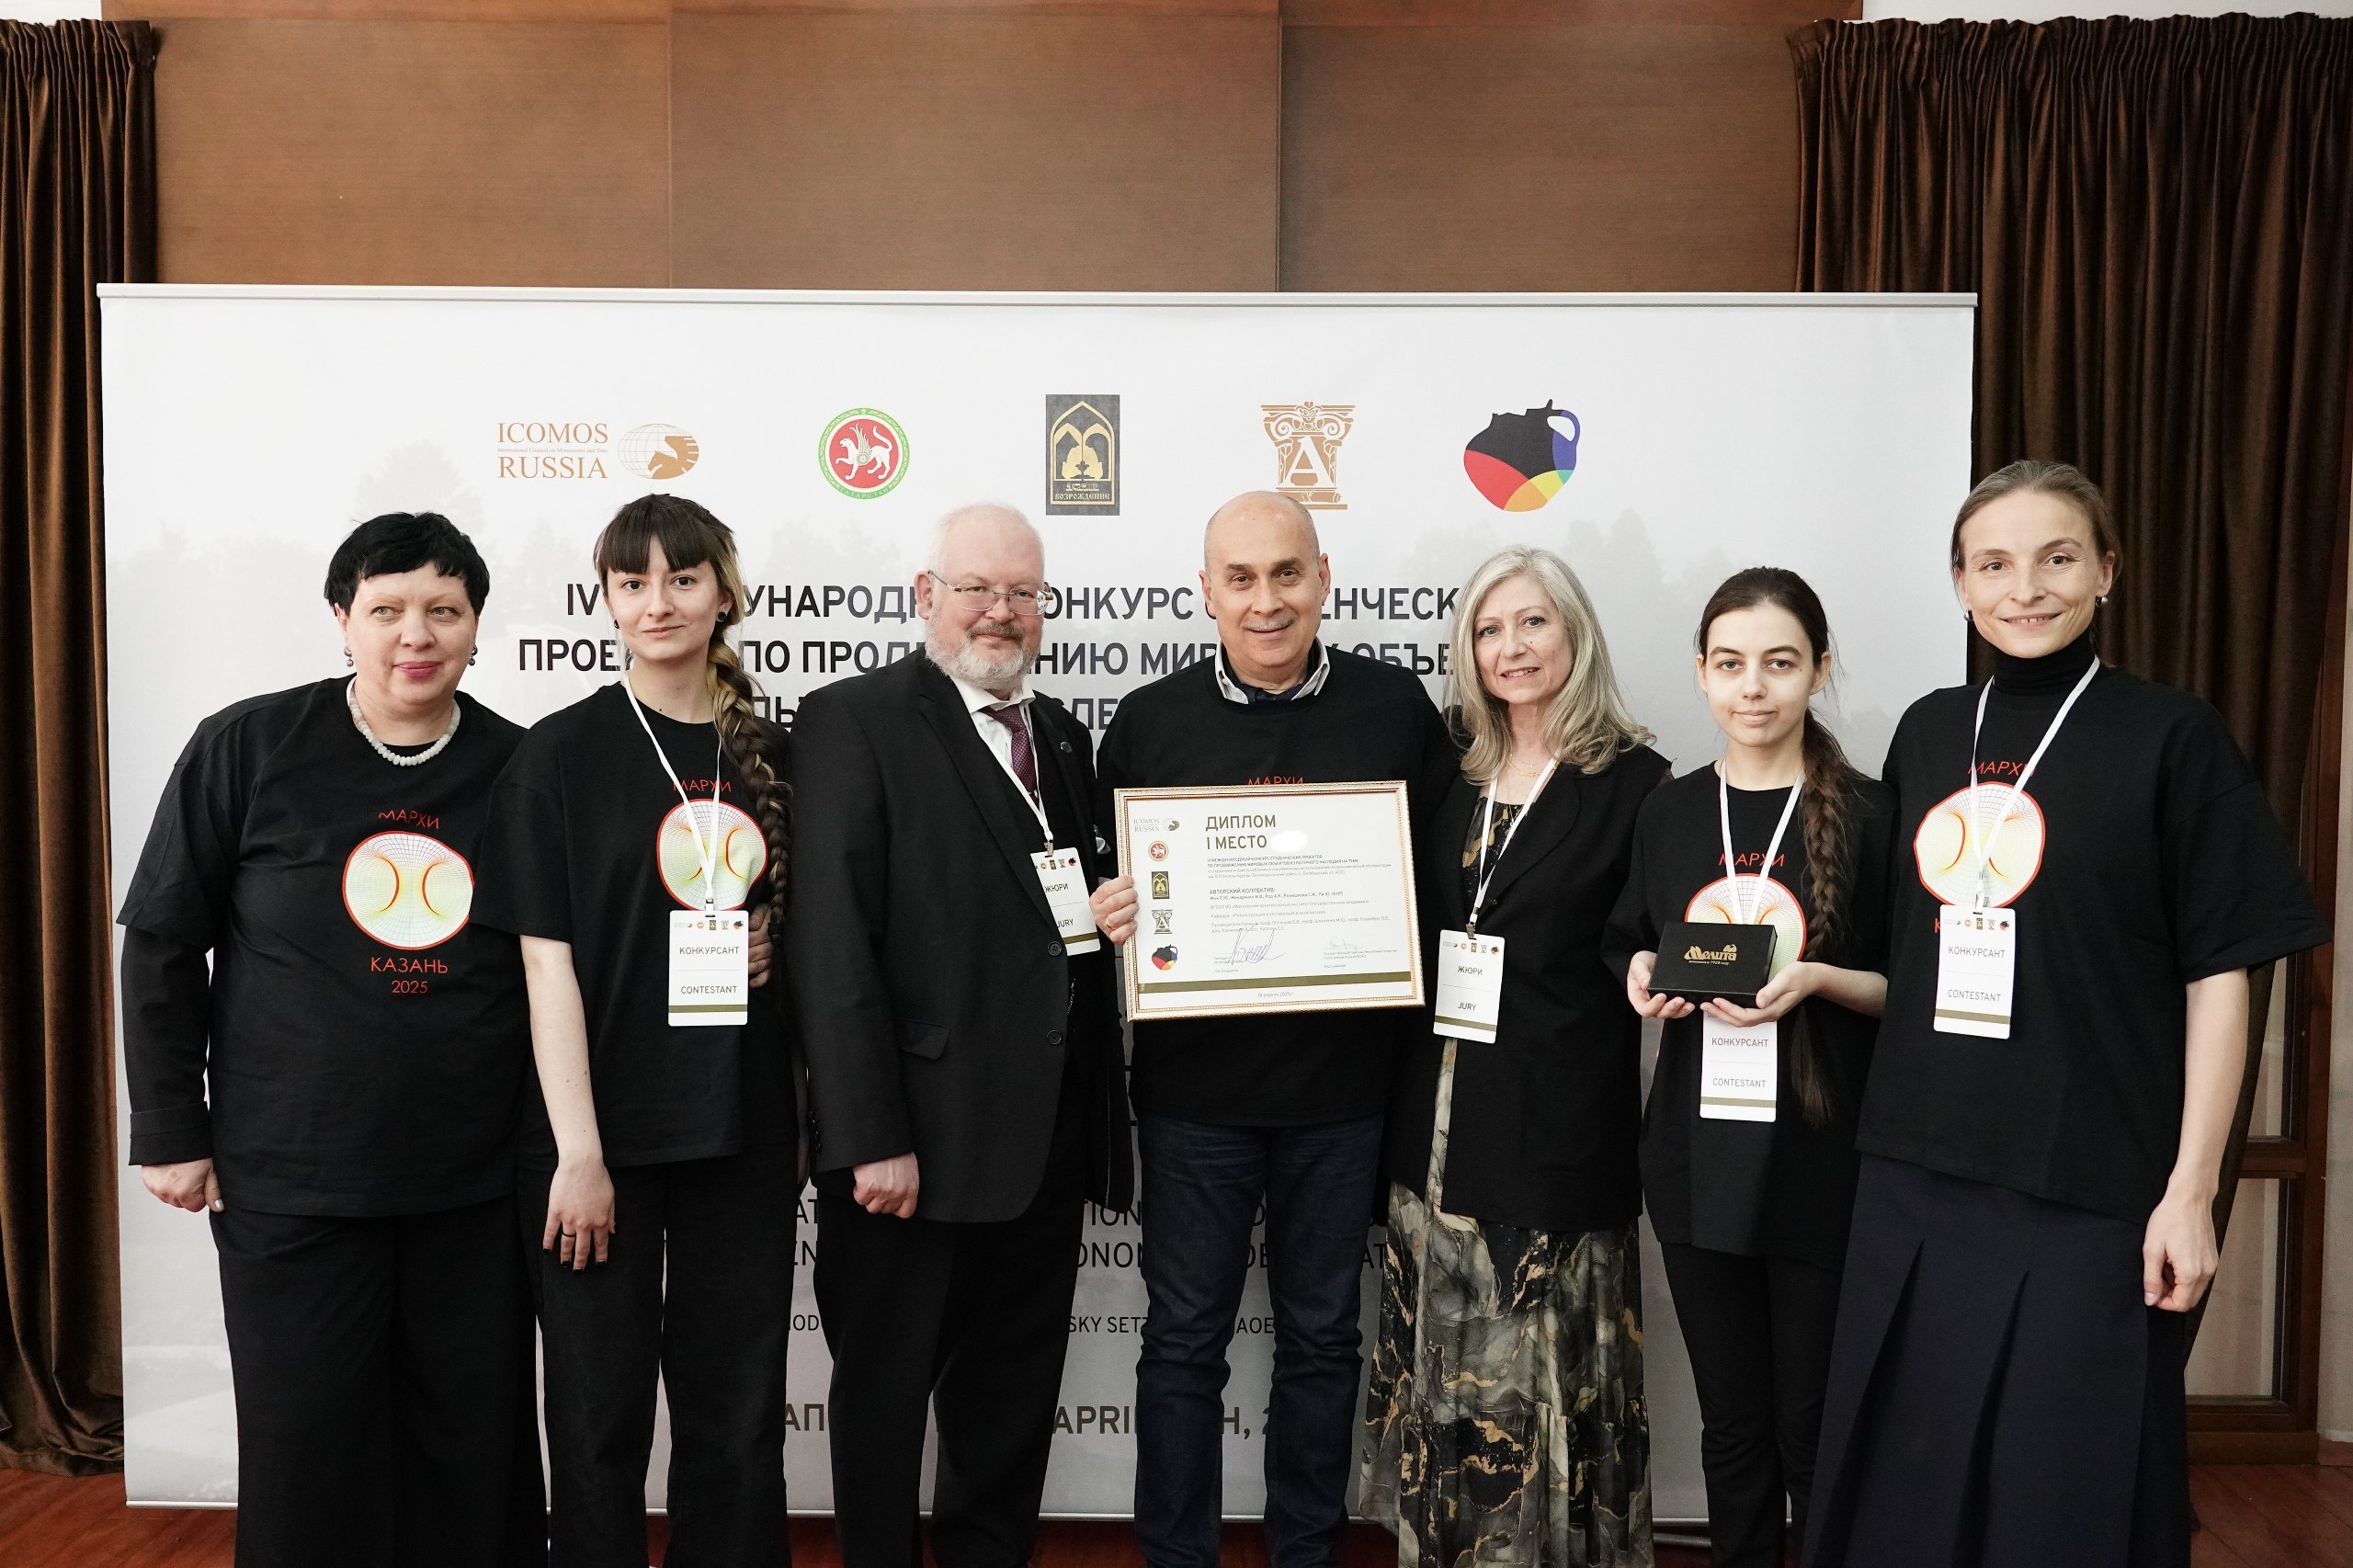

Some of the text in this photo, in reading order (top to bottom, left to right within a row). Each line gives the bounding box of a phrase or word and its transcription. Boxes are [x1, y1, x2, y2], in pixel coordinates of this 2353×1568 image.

[497, 422, 608, 443] ICOMOS
[498, 456, 608, 479] RUSSIA
[1054, 493, 1110, 501] ВОЗРОЖДЕНИЕ
[566, 583, 600, 616] IV
[1044, 586, 1194, 620] ОНКУРС
[518, 639, 631, 672] ПРОЕ
[740, 640, 790, 673] ПО
[378, 809, 440, 829] МАРХИ
[1205, 814, 1277, 832] ДИПЛОМ
[1215, 835, 1267, 850] МЕСТО
[1044, 882, 1069, 893] ЖЮРИ
[1209, 887, 1241, 895] АВТОРСКИЙ
[1056, 918, 1074, 928] JURY
[678, 946, 740, 956] КОНКУРСАНТ
[1948, 945, 2006, 959] КОНКУРСАНТ
[370, 957, 449, 974] КАЗАНЬ
[1457, 965, 1483, 976] ЖЮРИ
[391, 980, 428, 994] 2025
[680, 985, 738, 994] CONTESTANT
[1948, 988, 2002, 1003] CONTESTANT
[1458, 1002, 1477, 1012] JURY
[1711, 1037, 1769, 1048] КОНКУРСАНТ
[1712, 1077, 1768, 1089] CONTESTANT
[1052, 1405, 1133, 1434] APRI
